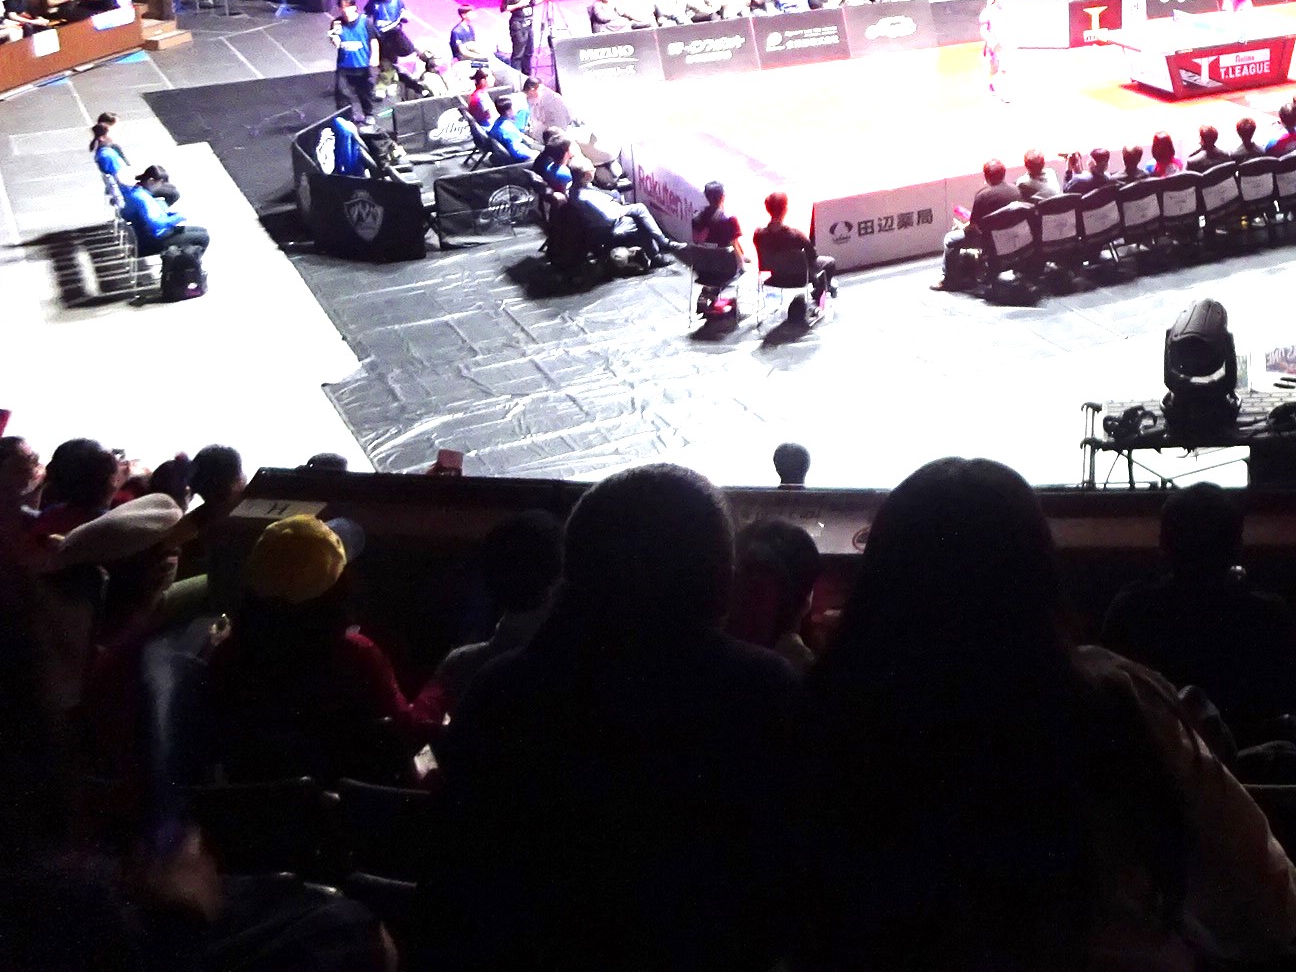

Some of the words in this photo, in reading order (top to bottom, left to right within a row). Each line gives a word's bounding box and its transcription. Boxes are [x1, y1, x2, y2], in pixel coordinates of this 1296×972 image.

[1219, 62, 1271, 80] T.LEAGUE
[858, 208, 934, 237] 田辺薬局
